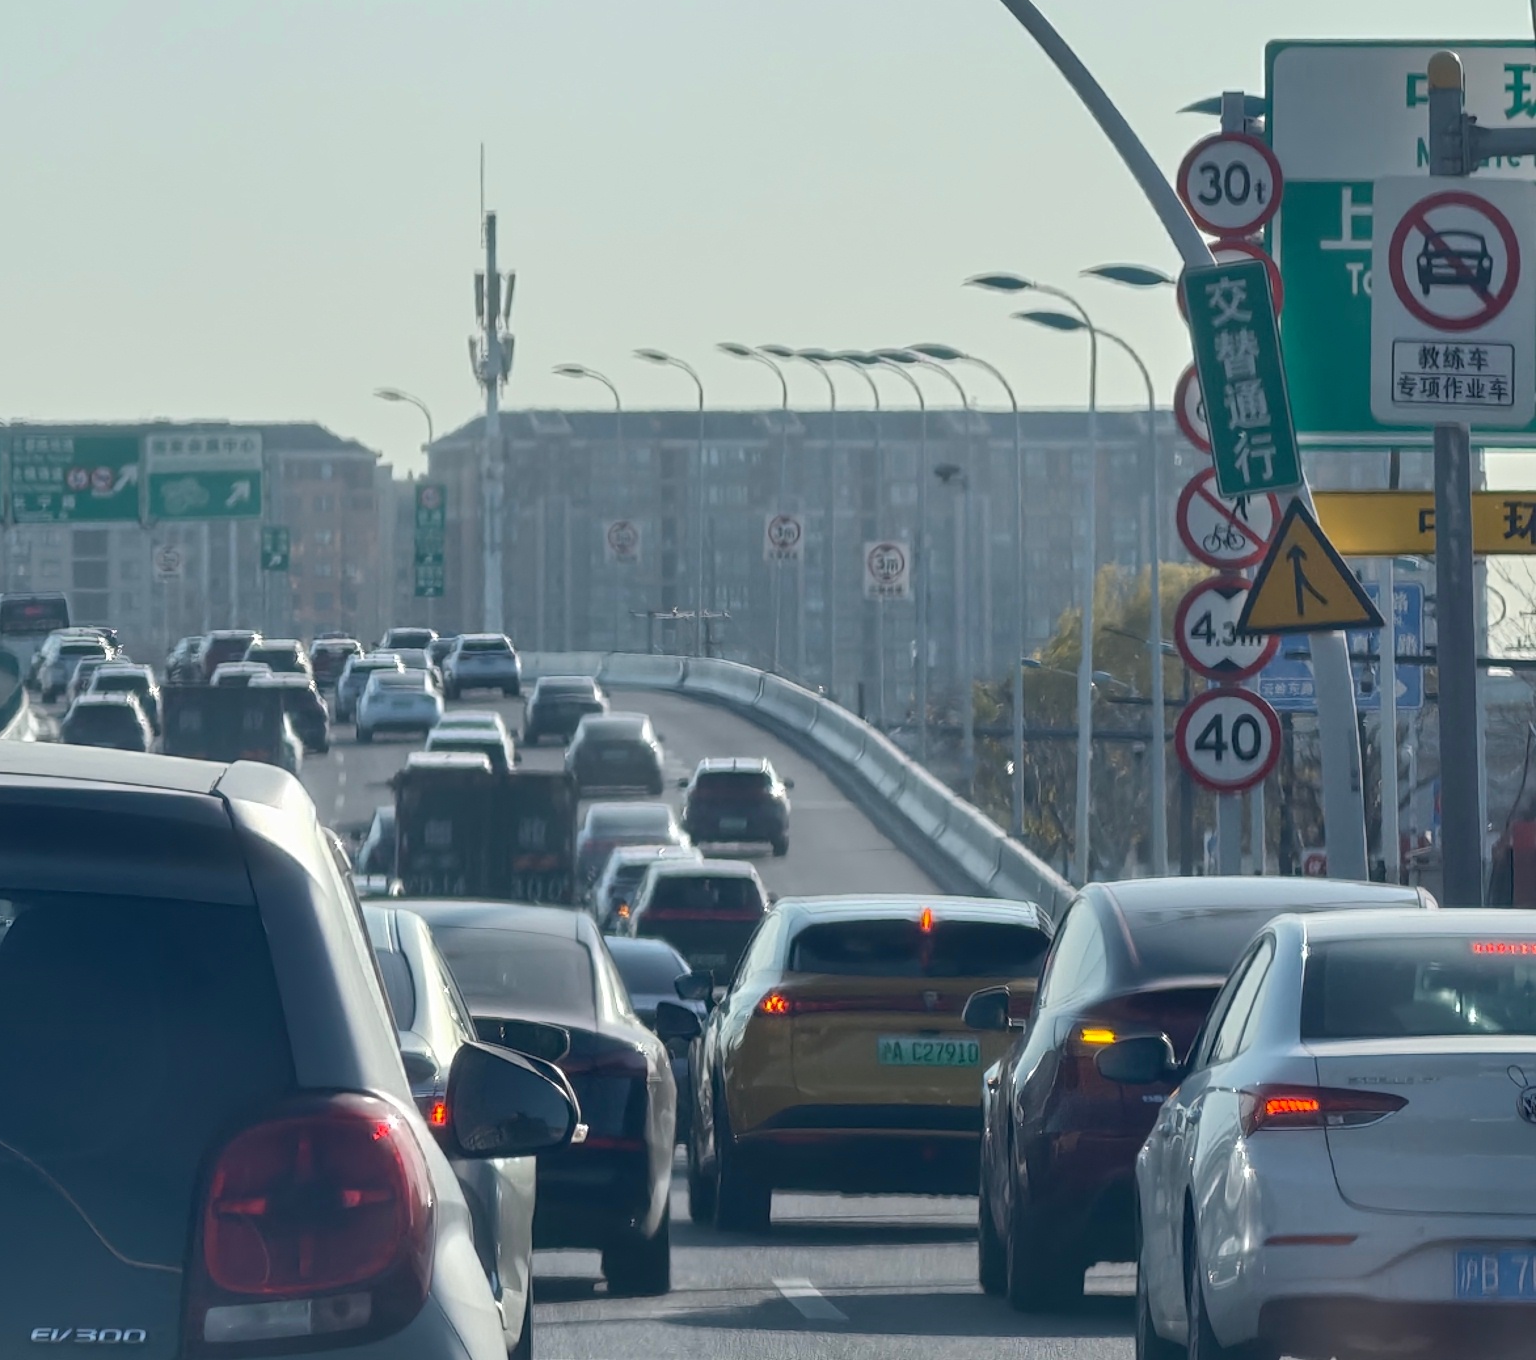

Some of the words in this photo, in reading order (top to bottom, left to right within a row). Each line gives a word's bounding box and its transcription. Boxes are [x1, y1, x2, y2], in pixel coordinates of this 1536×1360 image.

[1198, 160, 1266, 206] 30t
[1418, 344, 1489, 371] 教练车
[1205, 276, 1277, 485] 交替通行
[1396, 375, 1508, 401] 专项作业车
[1194, 713, 1262, 762] 40
[30, 1325, 147, 1346] EV300
